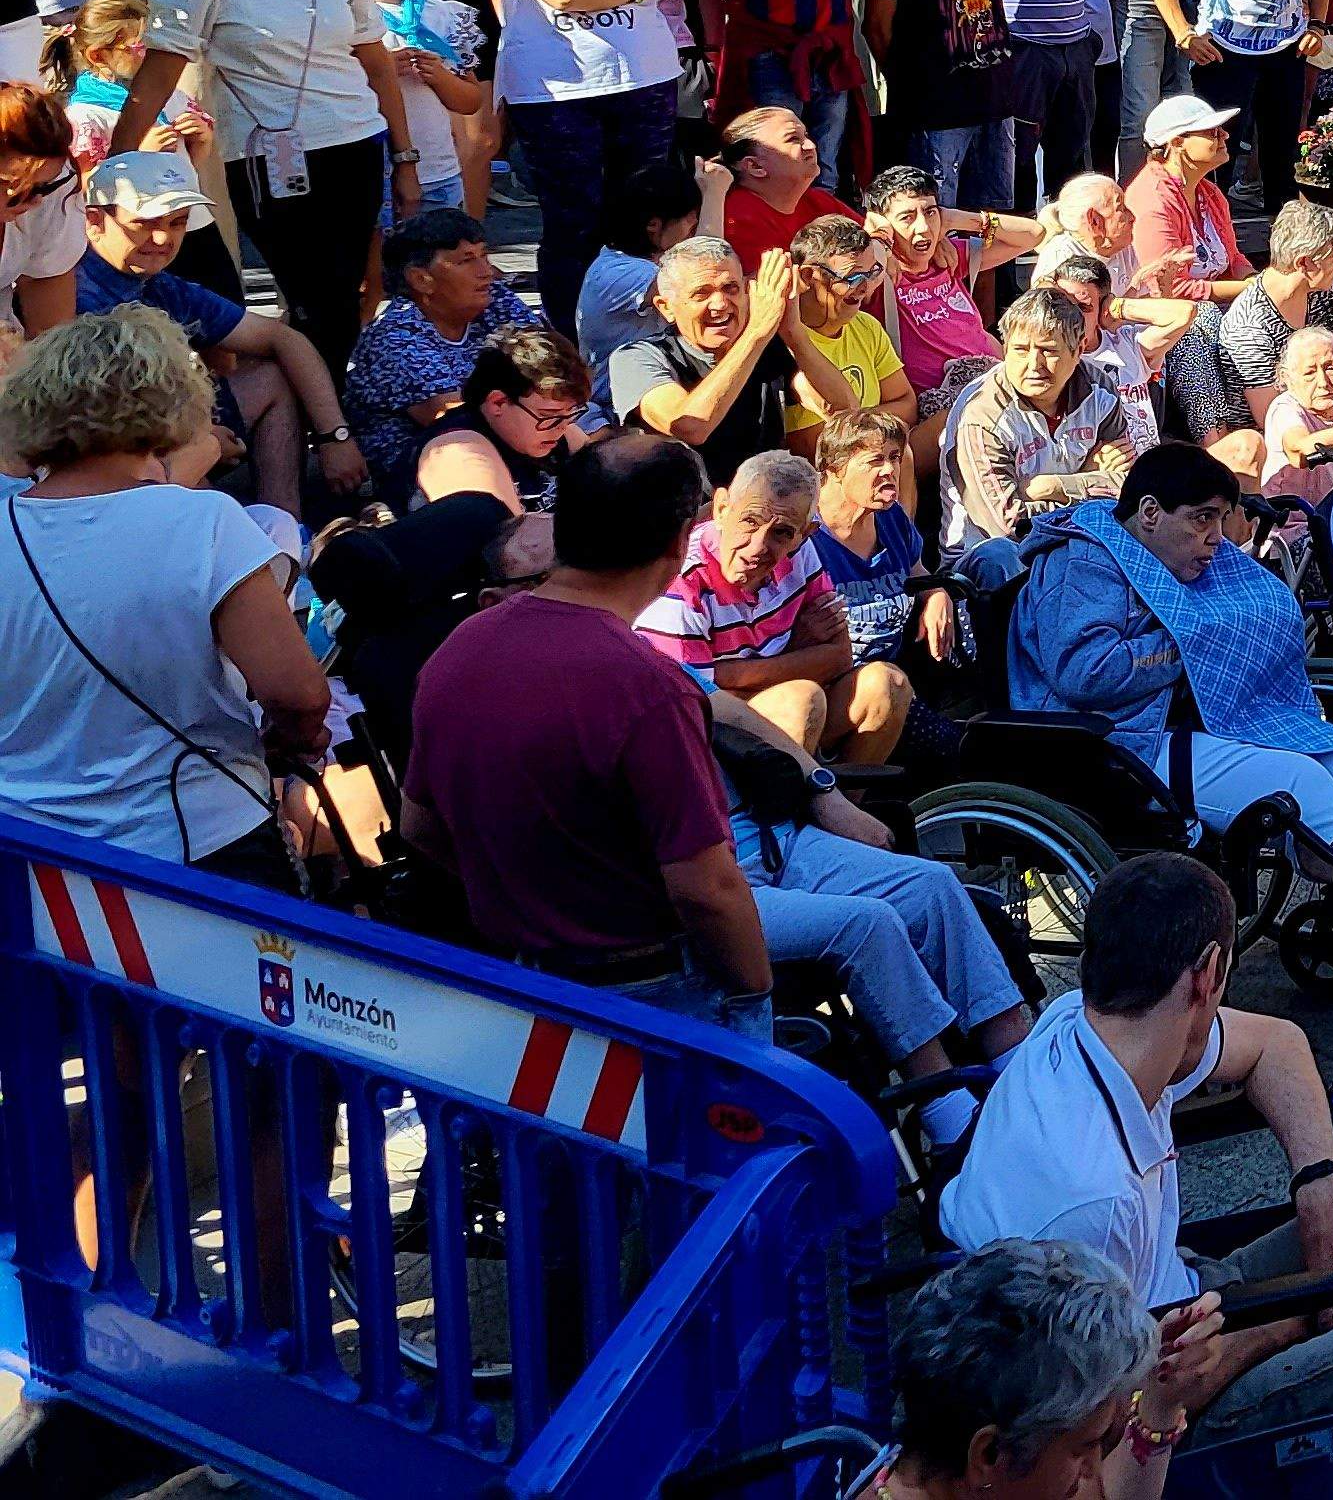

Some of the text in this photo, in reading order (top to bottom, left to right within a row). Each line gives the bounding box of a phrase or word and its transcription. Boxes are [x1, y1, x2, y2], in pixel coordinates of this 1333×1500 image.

[554, 7, 635, 30] Goofy
[304, 978, 396, 1031] Monzón
[306, 1010, 399, 1052] Ayuntamiento
